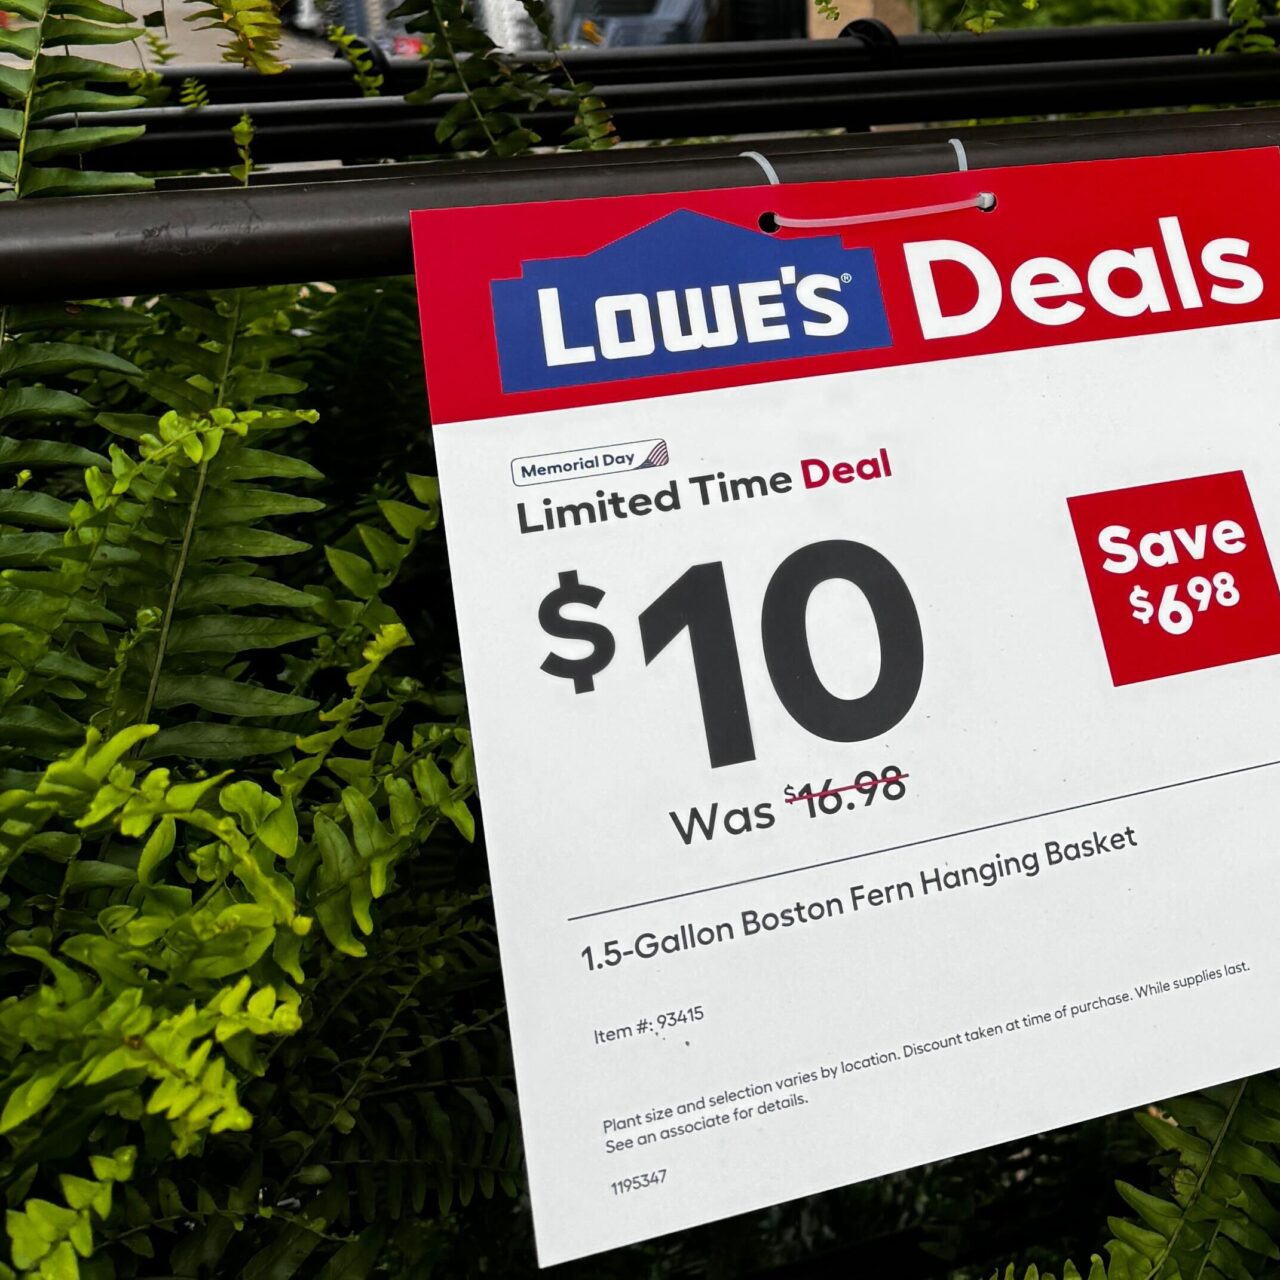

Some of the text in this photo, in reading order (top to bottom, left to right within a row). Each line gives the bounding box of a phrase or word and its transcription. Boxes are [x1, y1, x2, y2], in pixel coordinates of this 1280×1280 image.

[902, 215, 1264, 341] Deals
[516, 447, 893, 535] Limited Time Deal
[520, 453, 635, 479] Memorial Day
[1098, 519, 1248, 576] Save
[537, 539, 926, 770] $10
[668, 764, 910, 846] Was $16.98
[580, 825, 1138, 972] 1.5-Gallon Boston Fern Hanging Basket
[593, 1026, 633, 1045] Item
[658, 1005, 705, 1029] 93415
[602, 961, 1251, 1135] Plant size and selection varies by location. Discount taken at time of purchase. While supplies last.
[605, 1093, 809, 1154] See an associate for details.
[610, 1168, 667, 1196] 1195347
